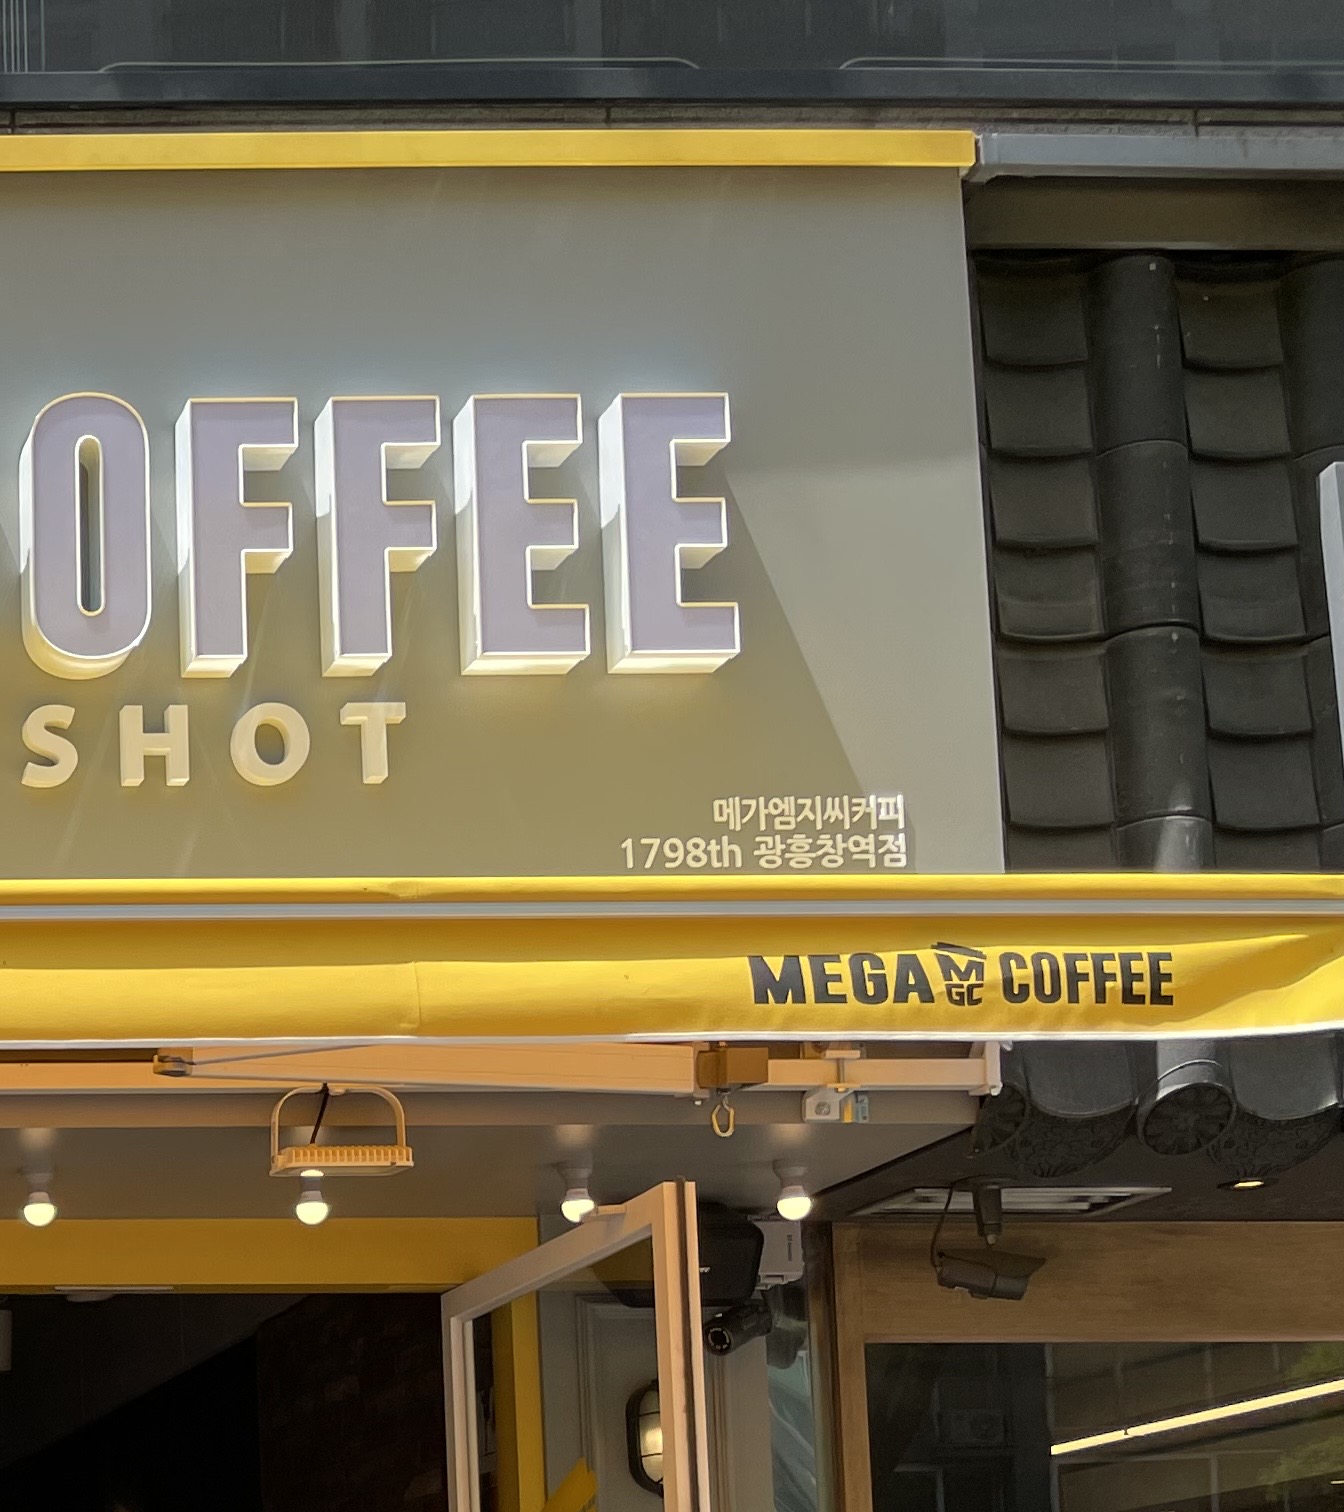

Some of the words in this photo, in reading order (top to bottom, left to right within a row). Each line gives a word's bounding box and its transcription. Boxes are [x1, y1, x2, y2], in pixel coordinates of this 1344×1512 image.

[20, 700, 407, 789] SHOT
[712, 794, 906, 831] 메가엠지씨커피
[620, 837, 743, 871] 1798th
[753, 833, 909, 869] 광흥창역점
[747, 953, 934, 1005] MEGA
[1001, 951, 1174, 1006] COFFEE
